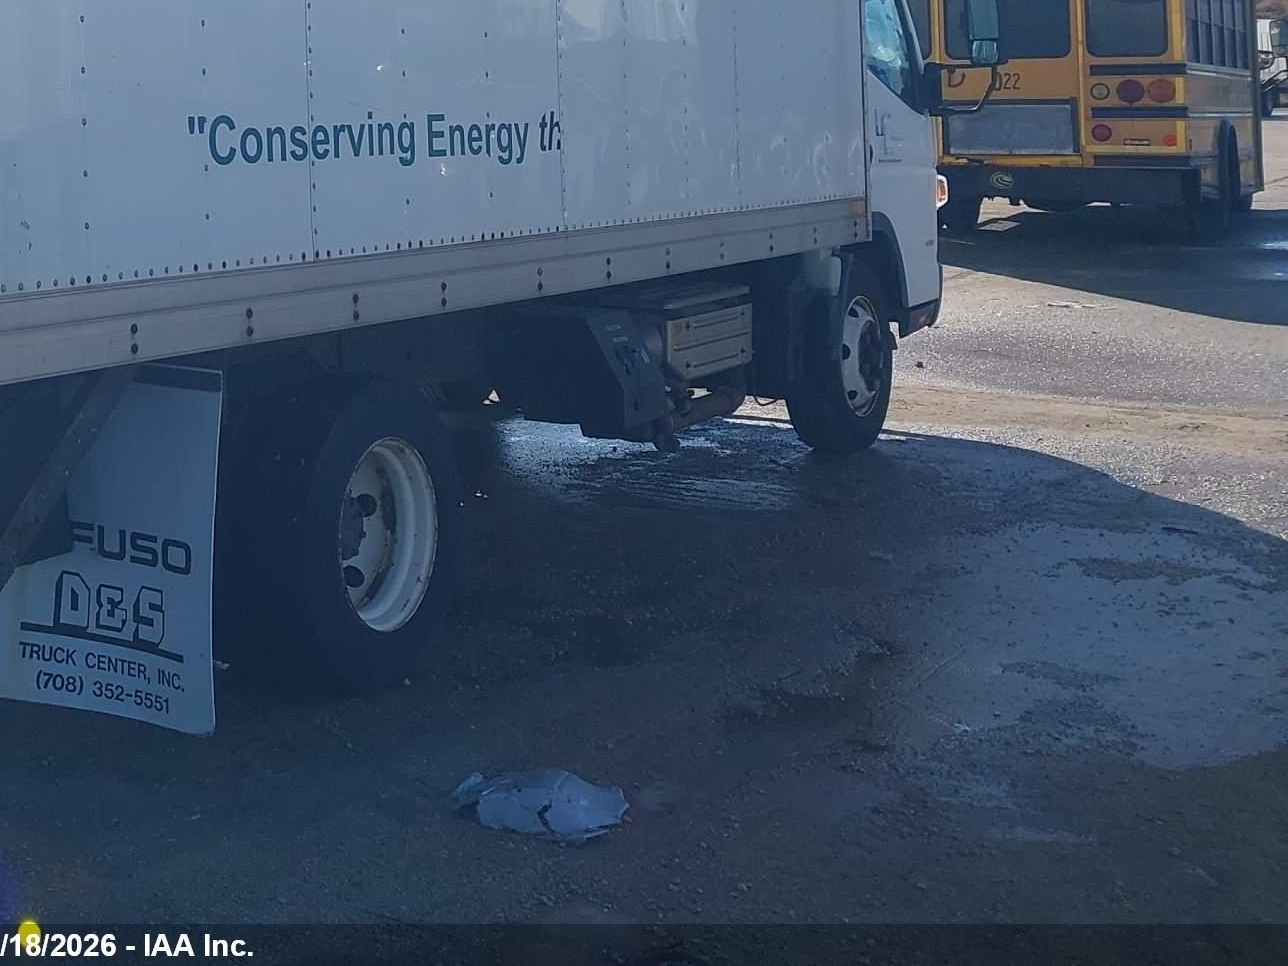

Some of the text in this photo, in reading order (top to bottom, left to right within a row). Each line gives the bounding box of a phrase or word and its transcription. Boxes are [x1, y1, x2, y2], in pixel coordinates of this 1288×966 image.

[187, 111, 416, 167] "Conserving
[427, 113, 530, 166] Energy
[18, 641, 185, 692] TRUCK CENTER, INC.
[34, 669, 170, 715] (708) 352-5551
